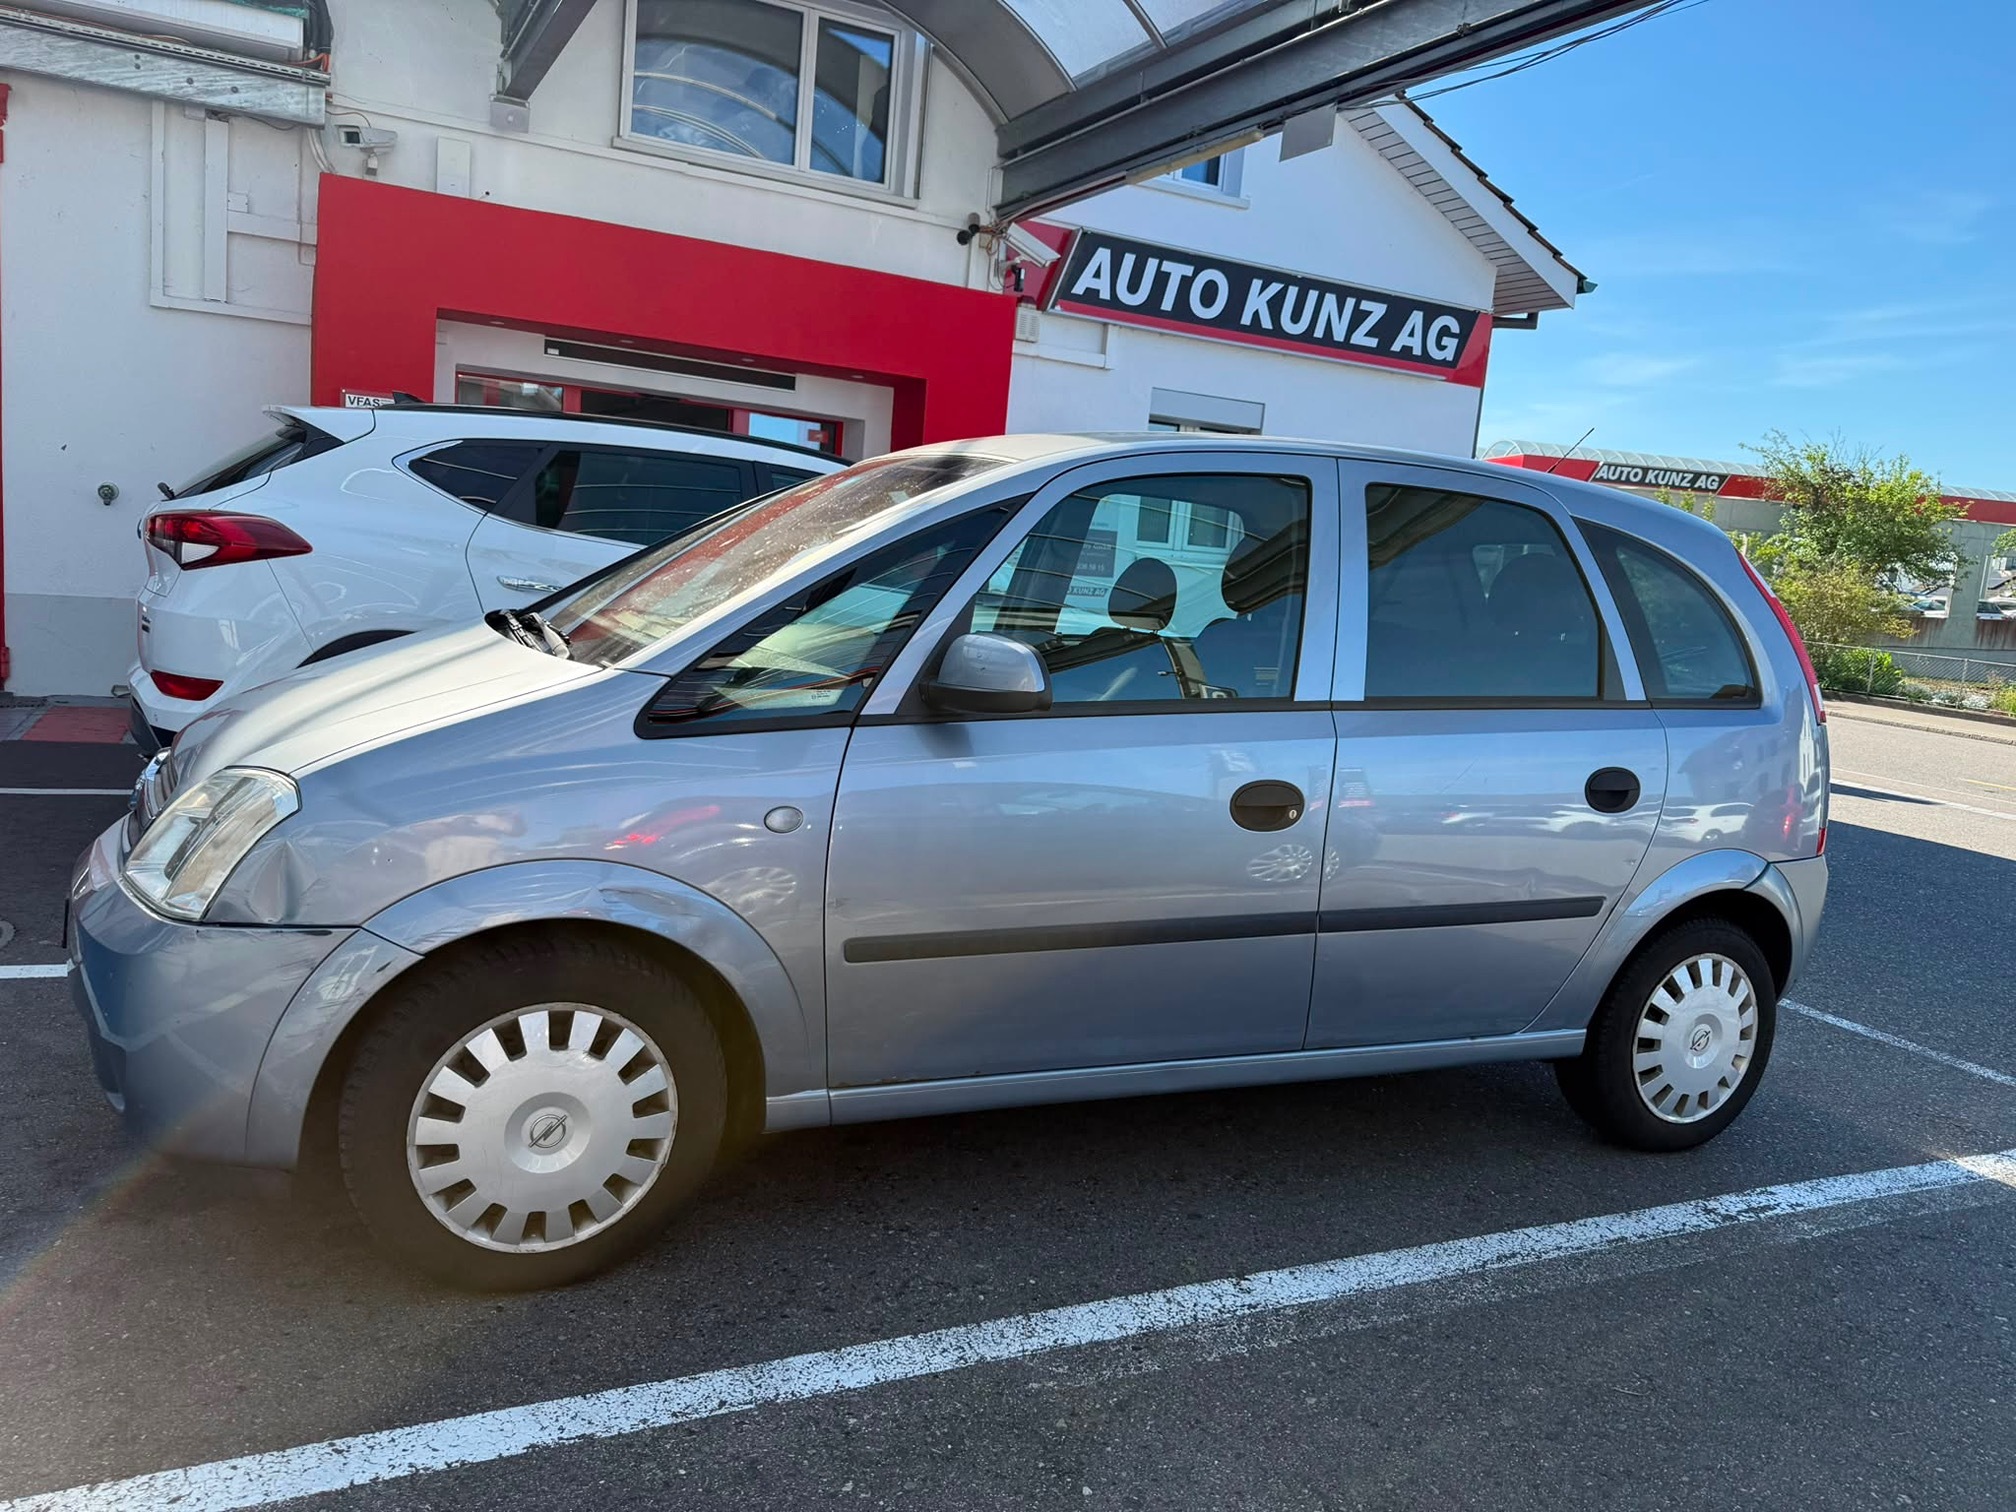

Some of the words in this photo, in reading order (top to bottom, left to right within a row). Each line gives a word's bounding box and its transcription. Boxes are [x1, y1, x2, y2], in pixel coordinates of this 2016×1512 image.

[1070, 246, 1229, 320] AUTO
[1240, 278, 1388, 348] KUNZ
[1390, 309, 1463, 362] AG
[347, 395, 380, 407] VFAS
[1596, 465, 1642, 482] AUTO
[1645, 469, 1693, 487] KUNZ
[1694, 475, 1719, 490] AG
